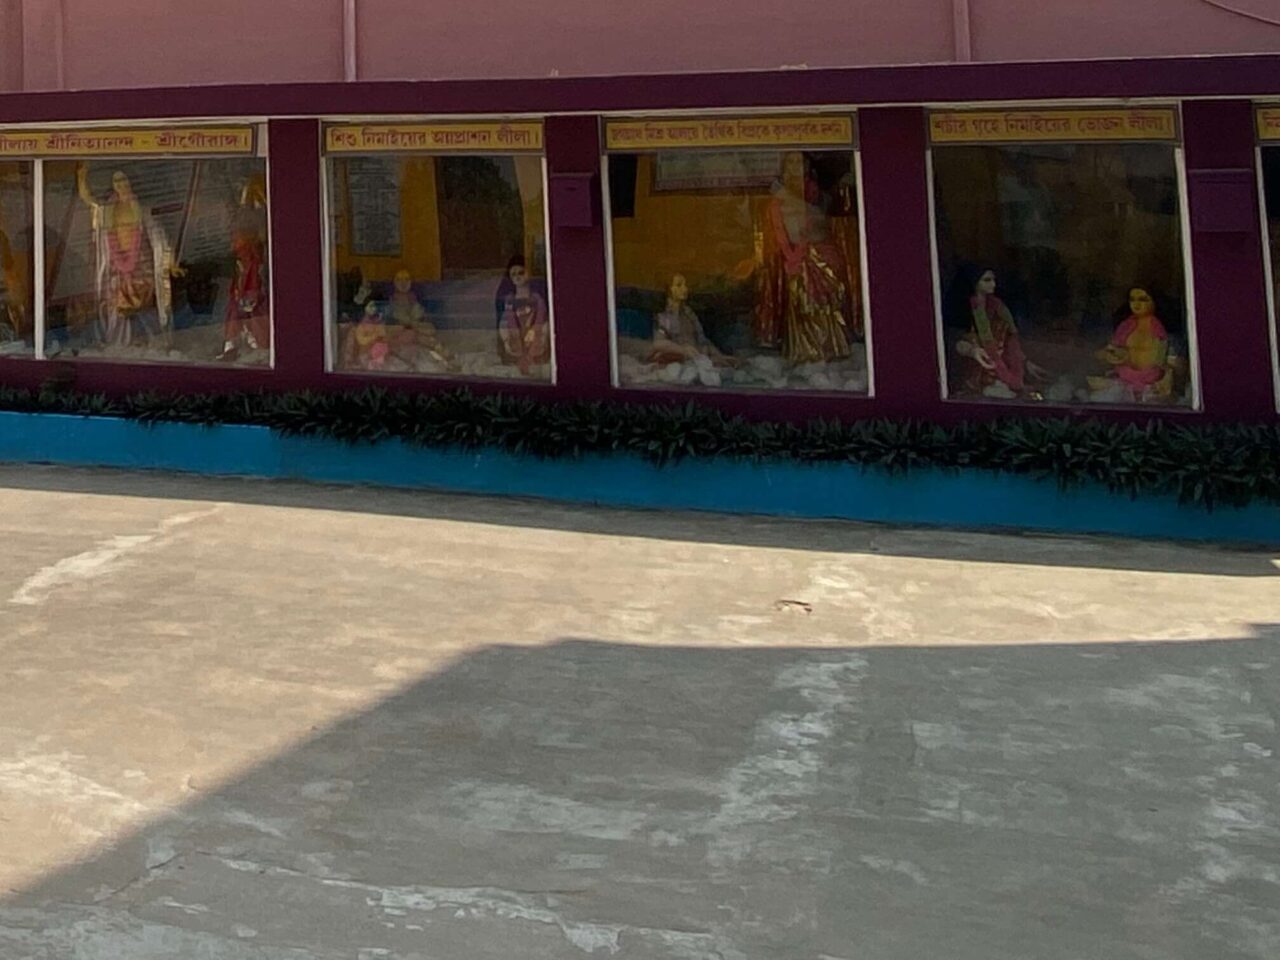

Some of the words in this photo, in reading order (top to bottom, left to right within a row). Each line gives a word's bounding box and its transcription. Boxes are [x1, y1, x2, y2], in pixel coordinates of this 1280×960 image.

[1005, 113, 1071, 133] নিমাইয়ের
[46, 133, 134, 150] শ্রীনিত্যানন্দ
[330, 128, 357, 146] শিশু
[362, 127, 426, 147] নিমাইয়ের
